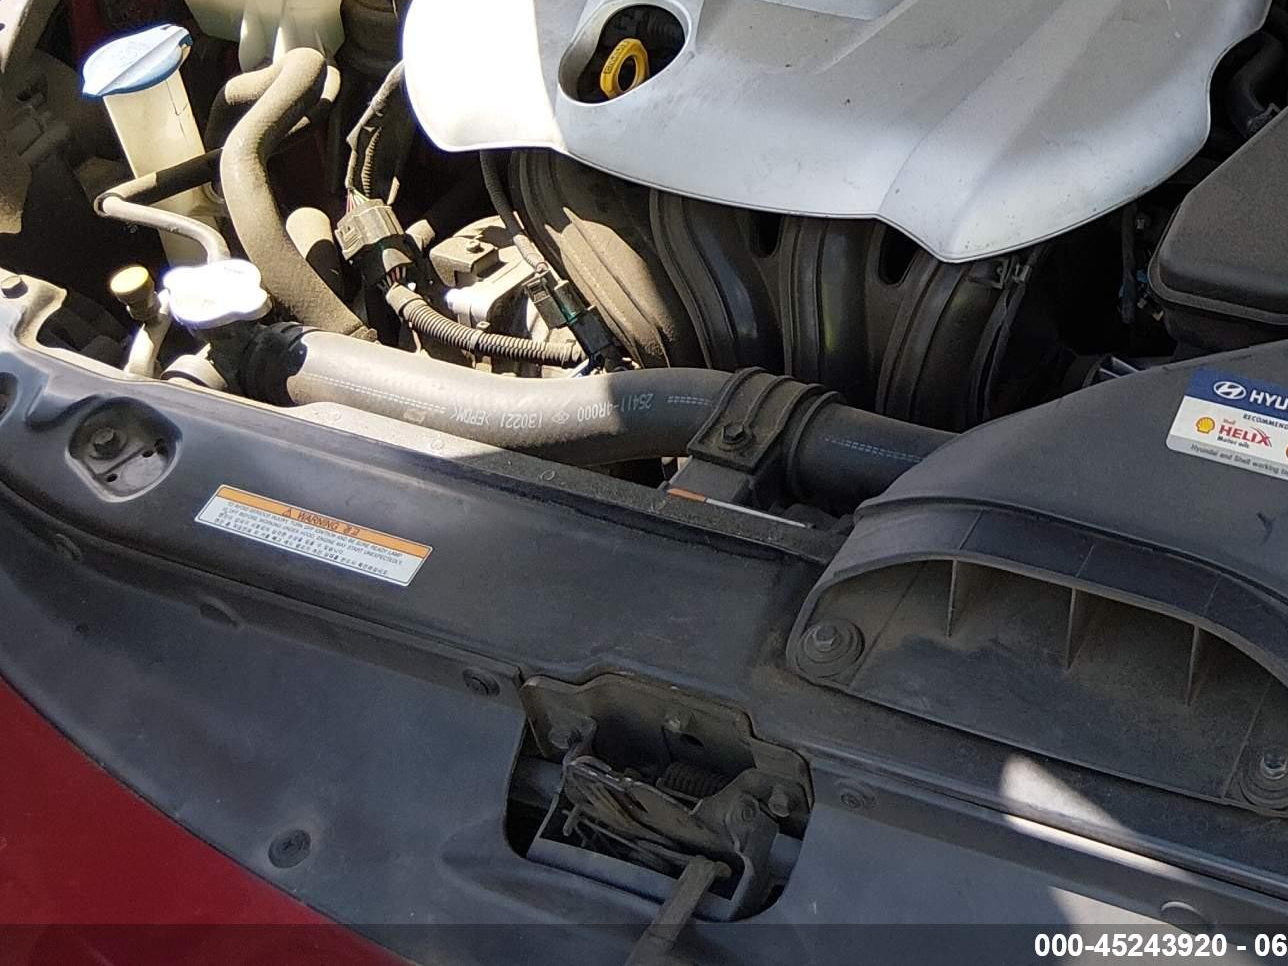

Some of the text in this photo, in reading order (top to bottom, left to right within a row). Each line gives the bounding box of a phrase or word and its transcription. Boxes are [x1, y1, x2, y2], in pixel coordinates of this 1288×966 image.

[577, 393, 653, 422] 25411-4R000
[500, 411, 544, 429] 130221
[1219, 424, 1272, 447] HELIX
[1190, 443, 1218, 456] Hyundai
[1220, 452, 1232, 461] and
[1252, 461, 1279, 474] working
[298, 511, 340, 531] WARNING
